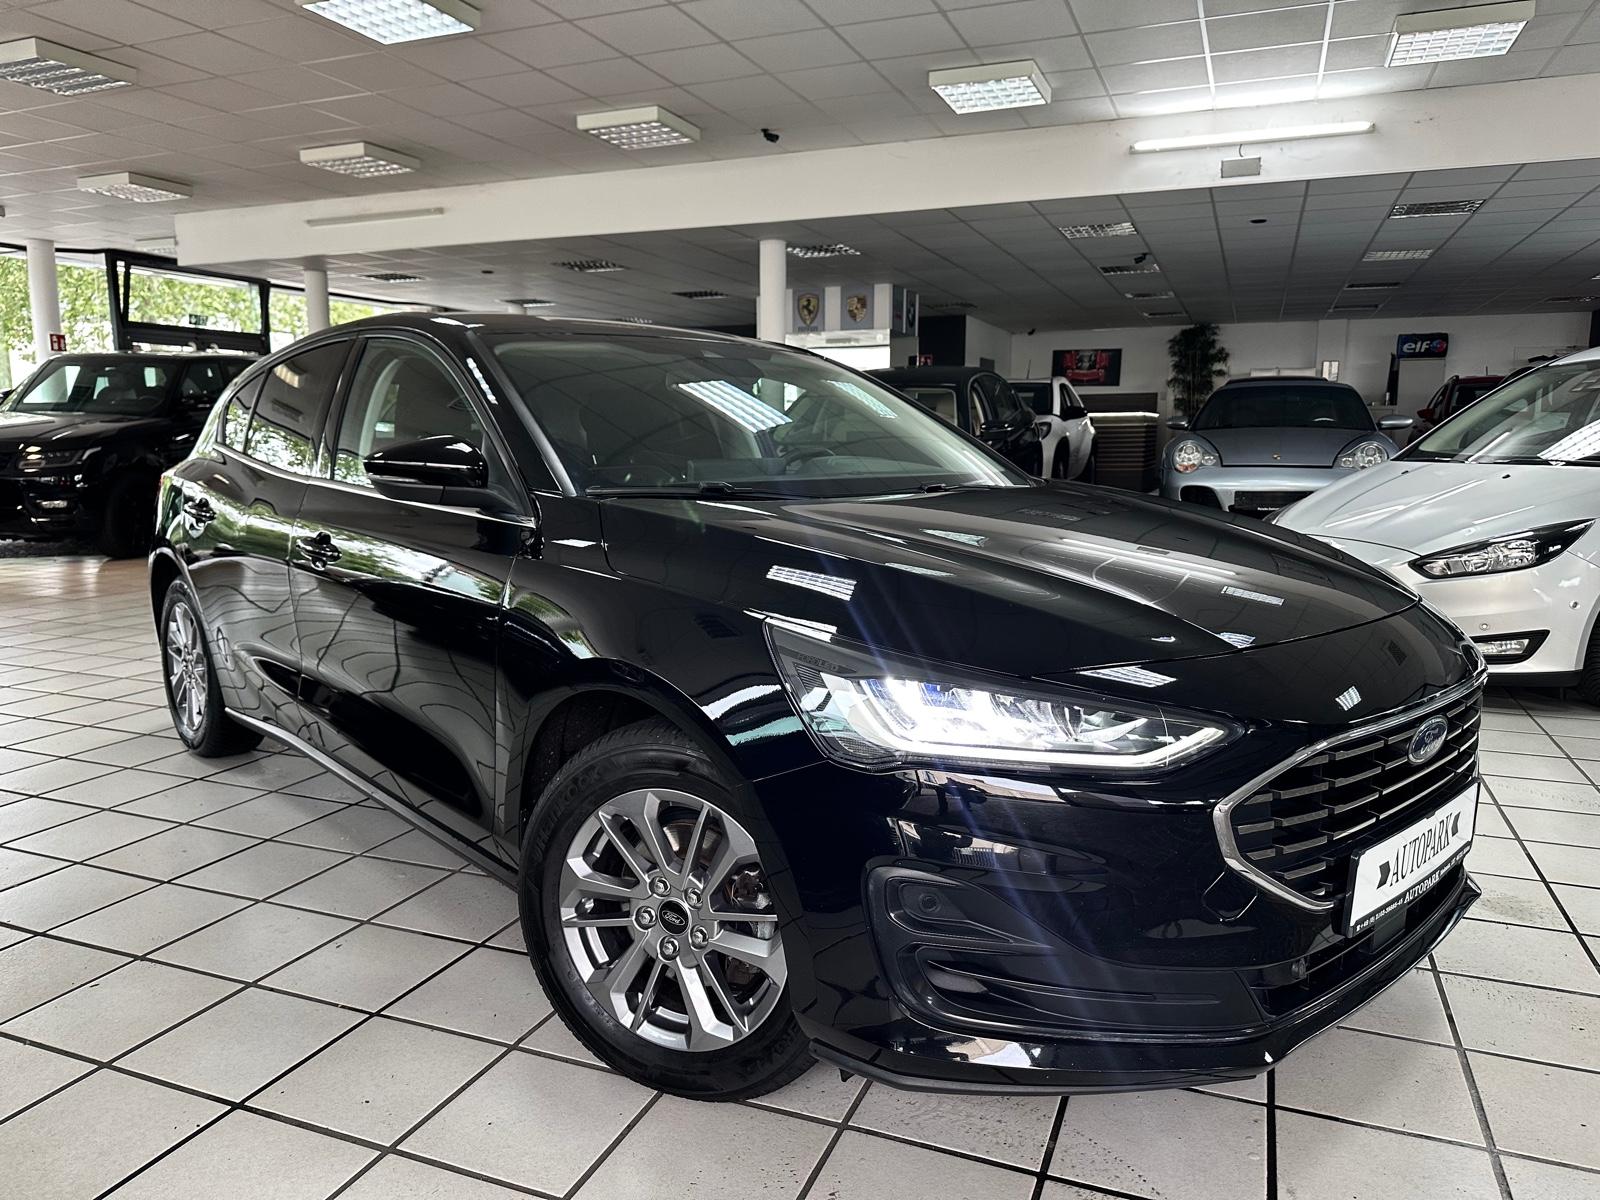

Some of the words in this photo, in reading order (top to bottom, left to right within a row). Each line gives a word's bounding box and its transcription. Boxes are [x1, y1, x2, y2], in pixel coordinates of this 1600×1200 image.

[1402, 340, 1430, 353] elf
[1389, 812, 1453, 887] AUTOPARK
[1404, 870, 1440, 904] AUTOPARK
